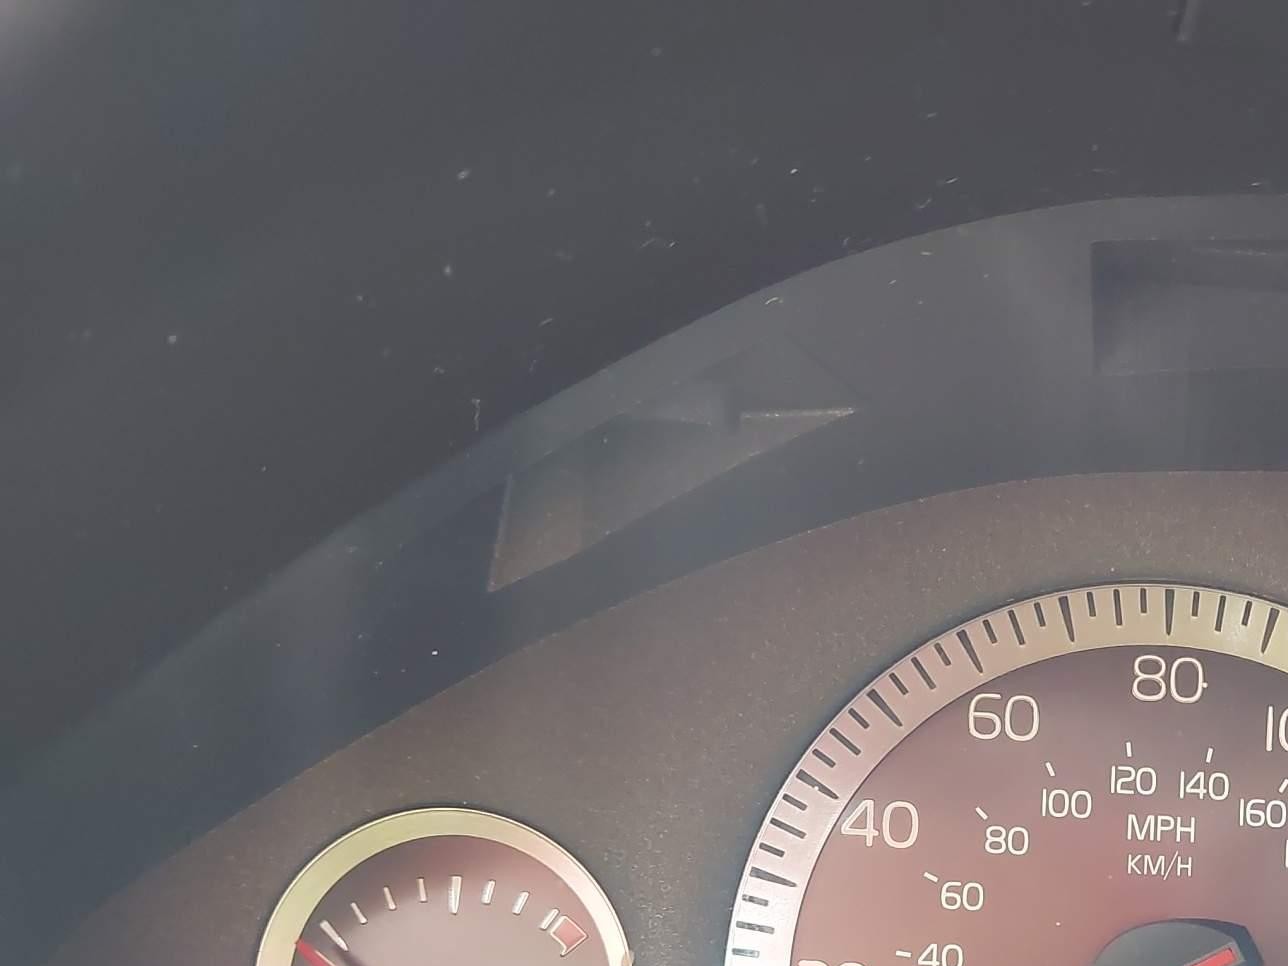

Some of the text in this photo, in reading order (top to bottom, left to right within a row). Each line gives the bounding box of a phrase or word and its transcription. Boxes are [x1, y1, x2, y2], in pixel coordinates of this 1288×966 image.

[1131, 656, 1204, 703] 80
[968, 694, 1039, 742] 60
[1109, 767, 1157, 796] 120
[1179, 771, 1229, 800] 140
[1041, 789, 1092, 819] 100
[1239, 800, 1286, 829] 160
[841, 800, 919, 849] 40
[1128, 815, 1195, 844] MPH
[984, 826, 1029, 855] 80
[1127, 854, 1192, 881] KM/H
[940, 883, 984, 912] 60
